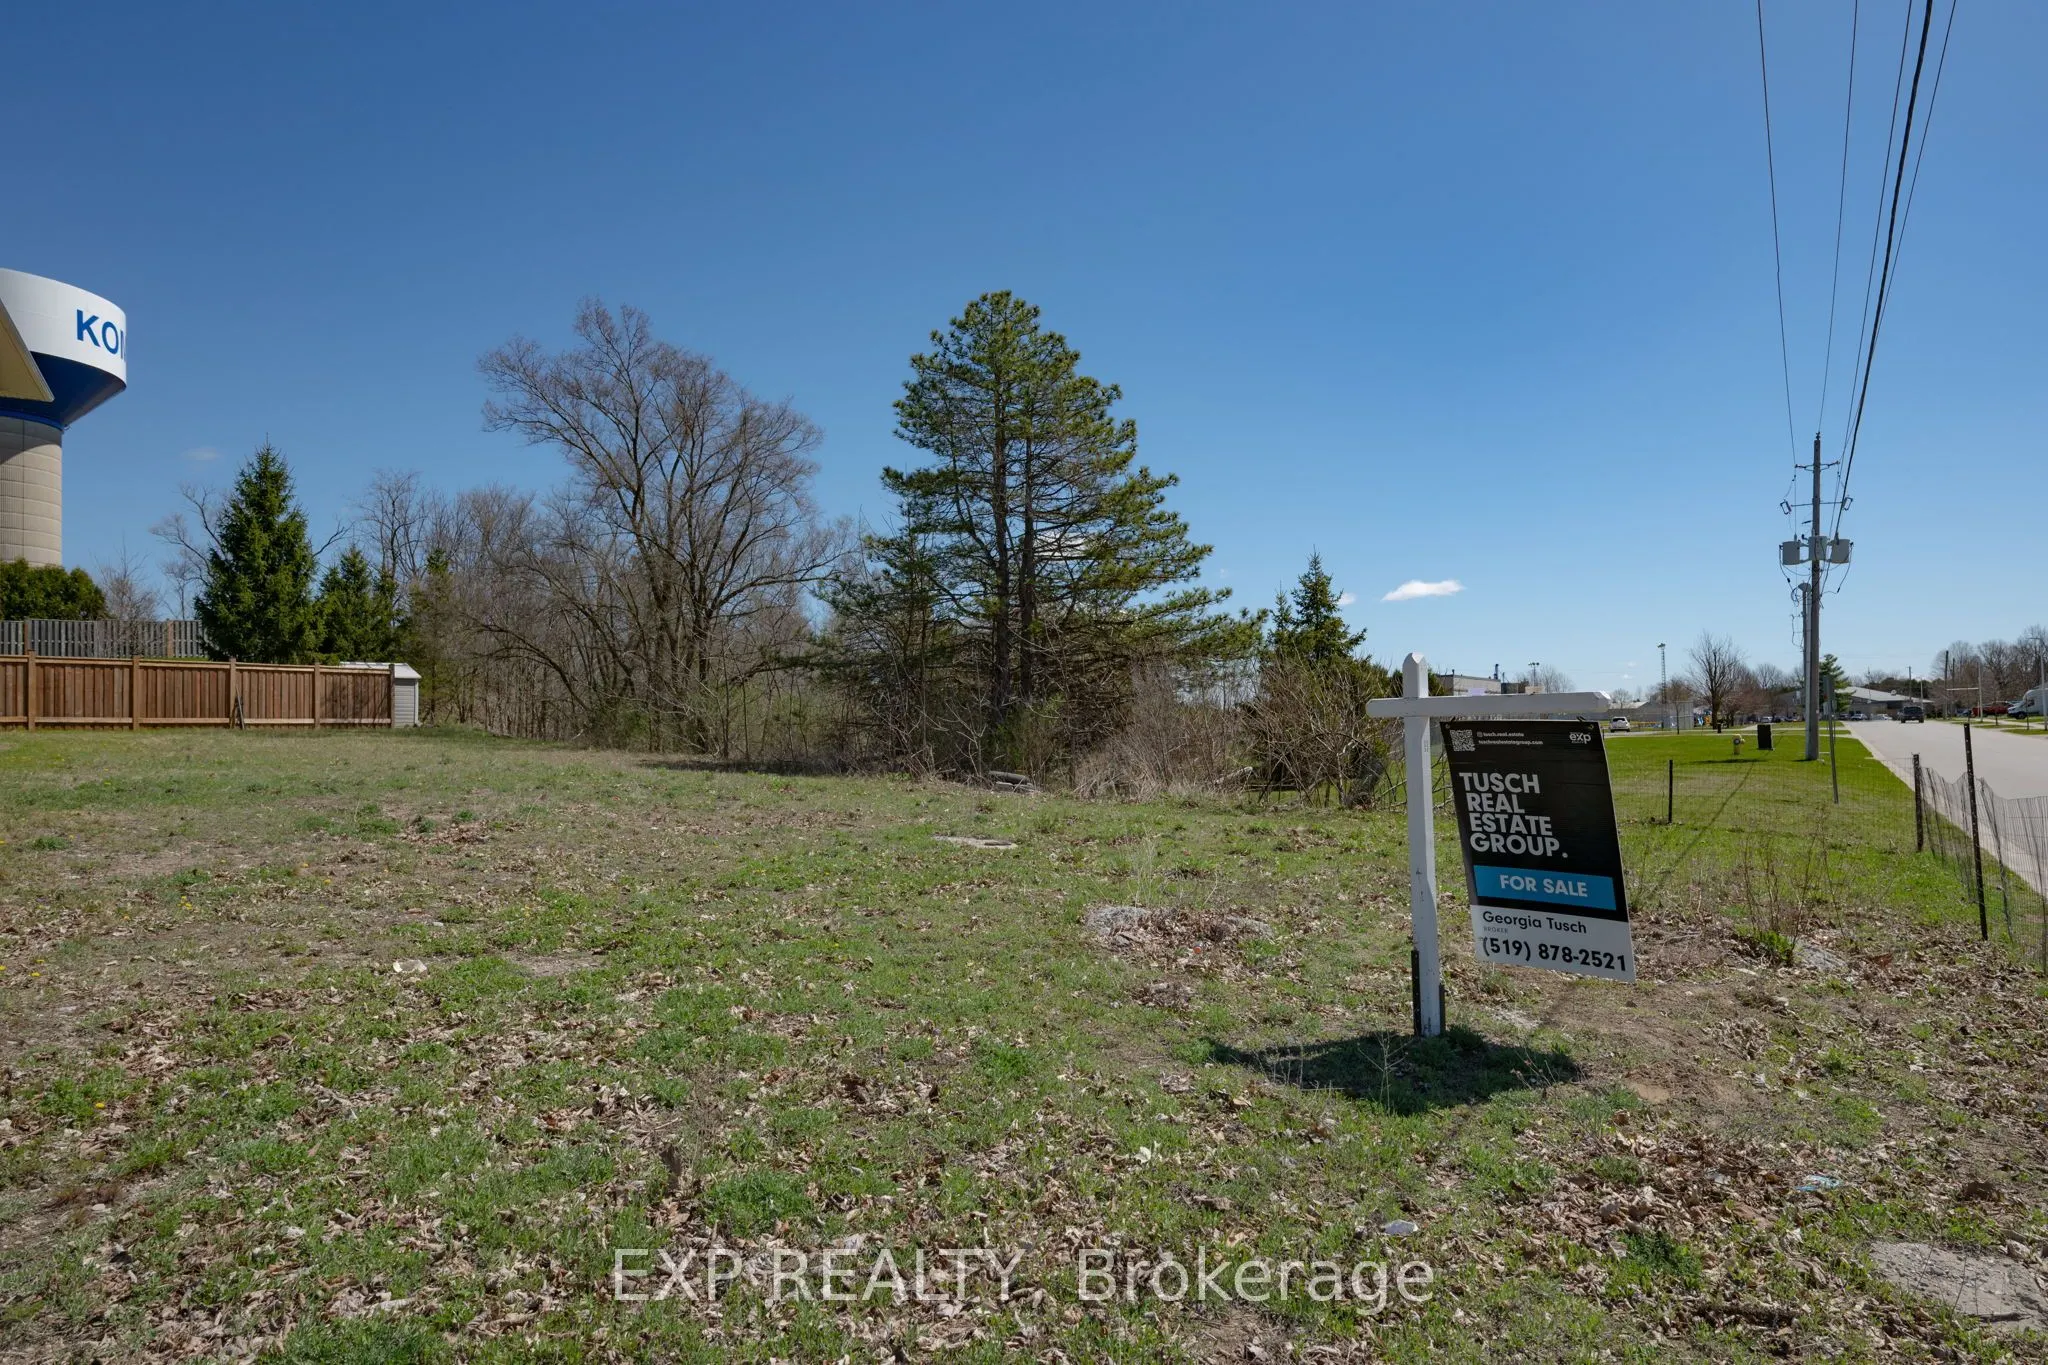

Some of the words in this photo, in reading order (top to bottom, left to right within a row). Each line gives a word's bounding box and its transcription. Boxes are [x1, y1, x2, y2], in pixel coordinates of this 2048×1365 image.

[77, 309, 125, 360] KO
[1459, 772, 1540, 794] TUSCH
[1466, 792, 1525, 814] REAL
[1469, 812, 1553, 836] ESTATE
[1470, 832, 1568, 858] GROUP.
[1500, 874, 1537, 892] FOR
[1543, 878, 1588, 897] SALE
[1482, 911, 1542, 930] Georgia
[1546, 917, 1587, 934] Tusch
[1484, 926, 1508, 934] BROKER
[1482, 936, 1531, 962] (519)
[1538, 943, 1626, 972] 878-2521
